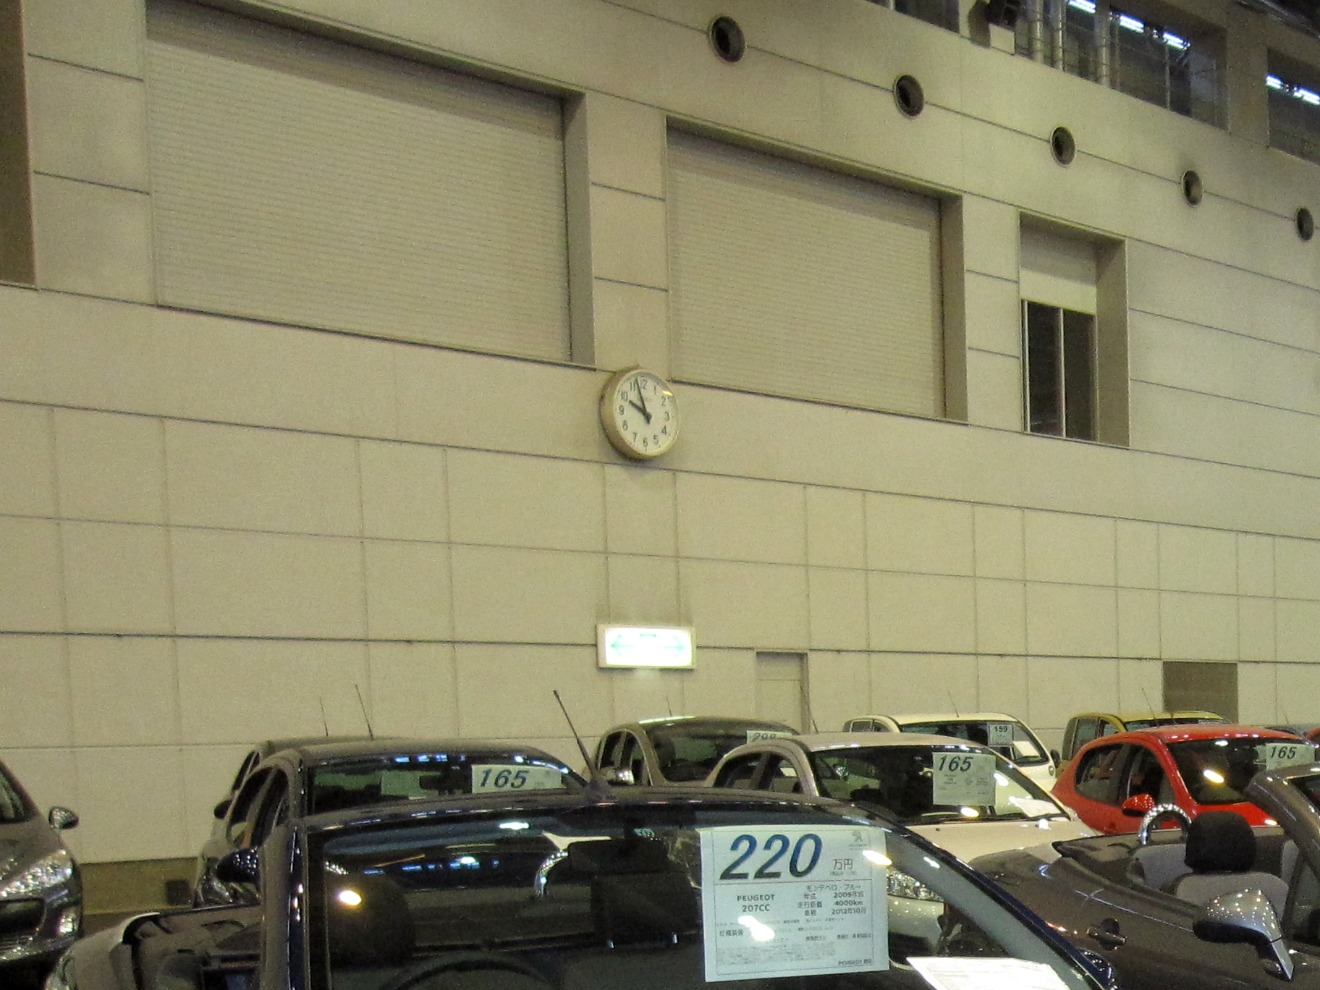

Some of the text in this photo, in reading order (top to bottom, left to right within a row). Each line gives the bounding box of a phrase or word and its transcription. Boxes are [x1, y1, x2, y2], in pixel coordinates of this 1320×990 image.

[653, 385, 657, 395] 1
[620, 391, 628, 401] 10
[661, 395, 667, 406] 2
[618, 404, 624, 415] 9
[664, 411, 670, 421] 3
[622, 420, 628, 430] 8
[661, 425, 667, 435] 4
[632, 432, 637, 442] 7
[642, 437, 648, 447] 6
[653, 434, 659, 445] 5
[1271, 746, 1297, 759] 165
[938, 755, 974, 772] 165
[479, 769, 527, 789] 165
[719, 833, 823, 881] 220
[833, 858, 853, 870] 万円
[736, 894, 776, 902] PEUGEOT
[742, 904, 770, 912] 207CC
